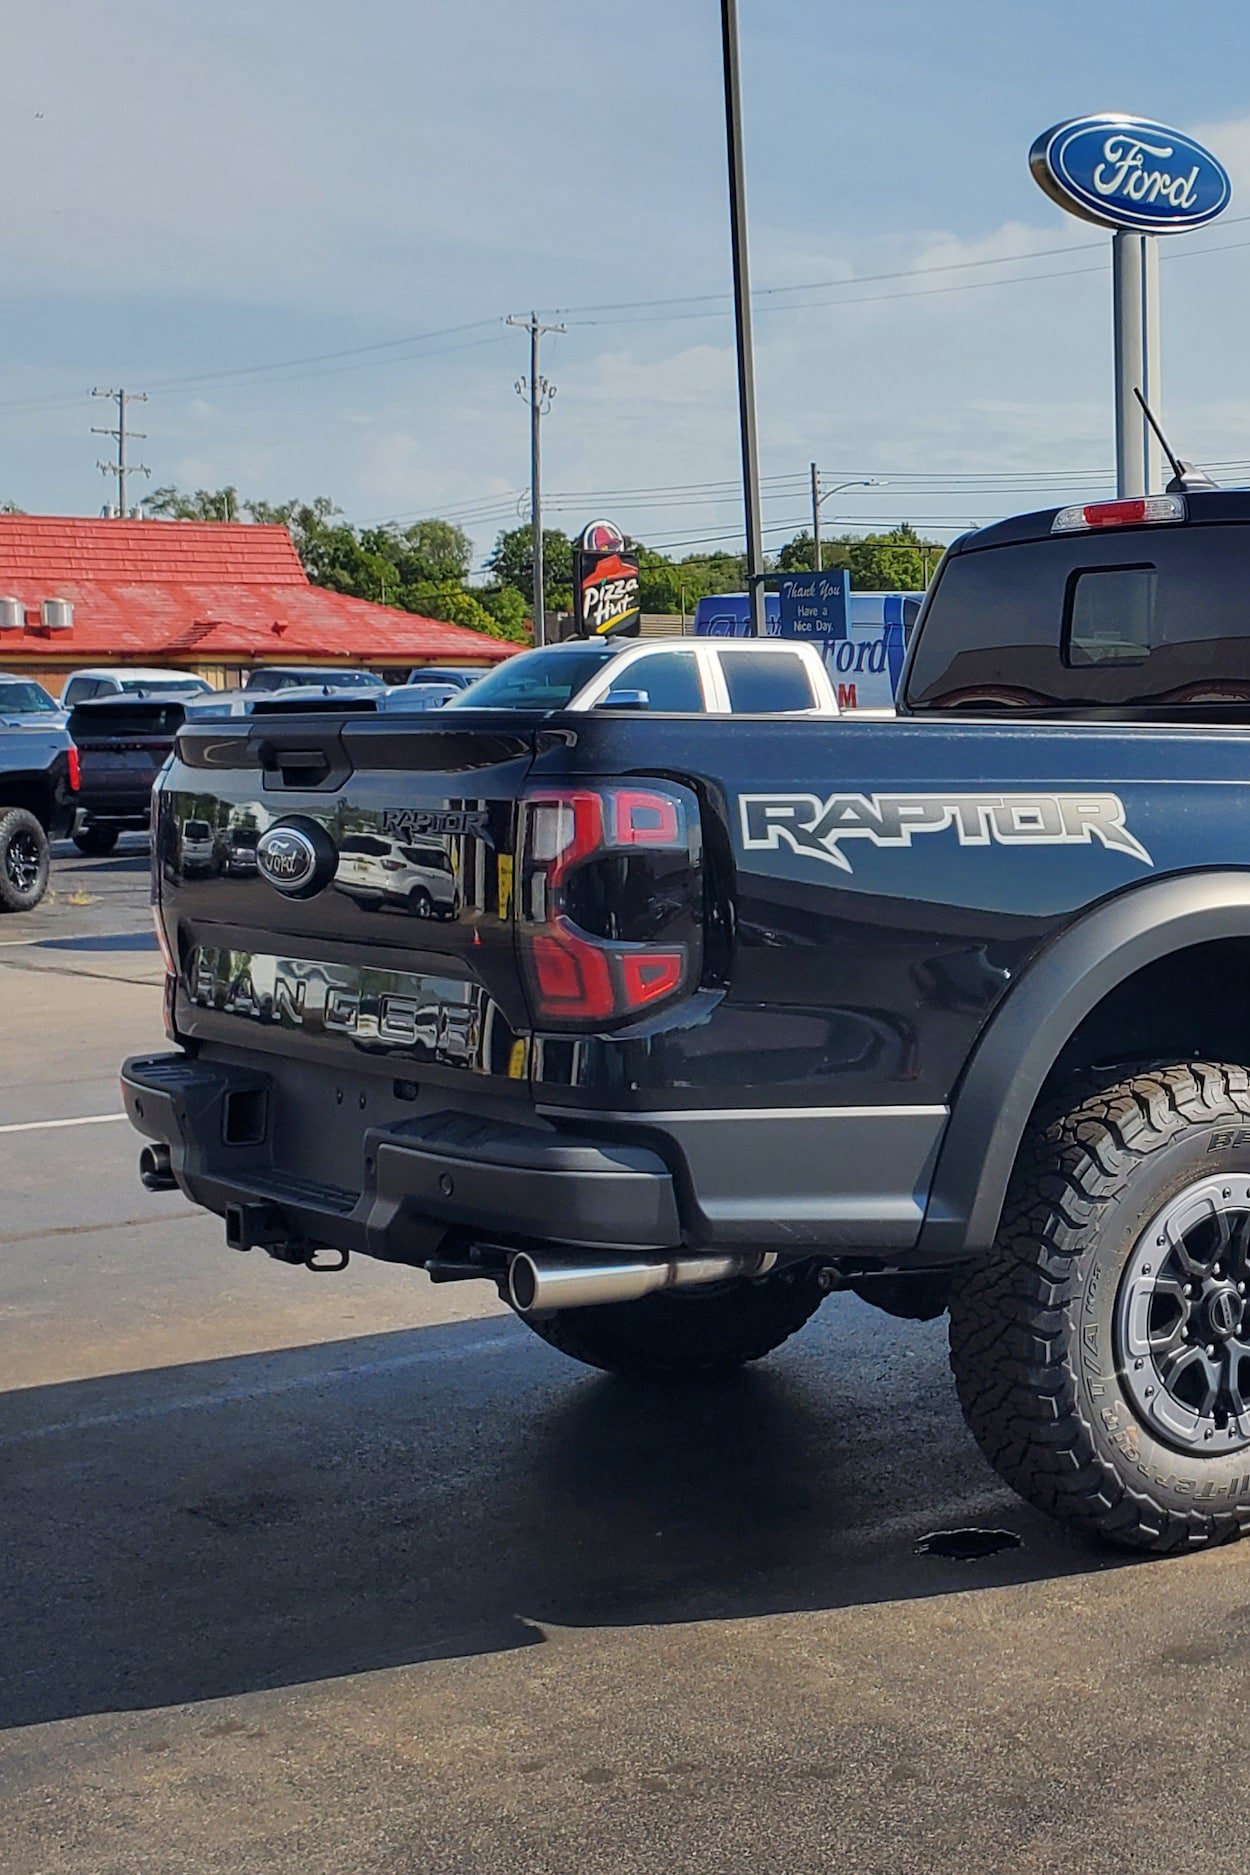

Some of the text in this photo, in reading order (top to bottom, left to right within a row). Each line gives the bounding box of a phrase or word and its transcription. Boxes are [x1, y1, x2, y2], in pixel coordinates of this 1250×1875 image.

[1094, 135, 1200, 209] Ford
[583, 577, 639, 620] Pizza
[593, 594, 635, 626] Hut
[783, 579, 841, 601] Thank You
[797, 605, 828, 617] Have a
[793, 620, 812, 632] Nice
[383, 808, 496, 850] RAPTOR
[738, 793, 1154, 874] RAPTOR
[265, 839, 297, 875] Ford
[189, 950, 481, 1069] RANGER
[1083, 1322, 1106, 1404] T/A
